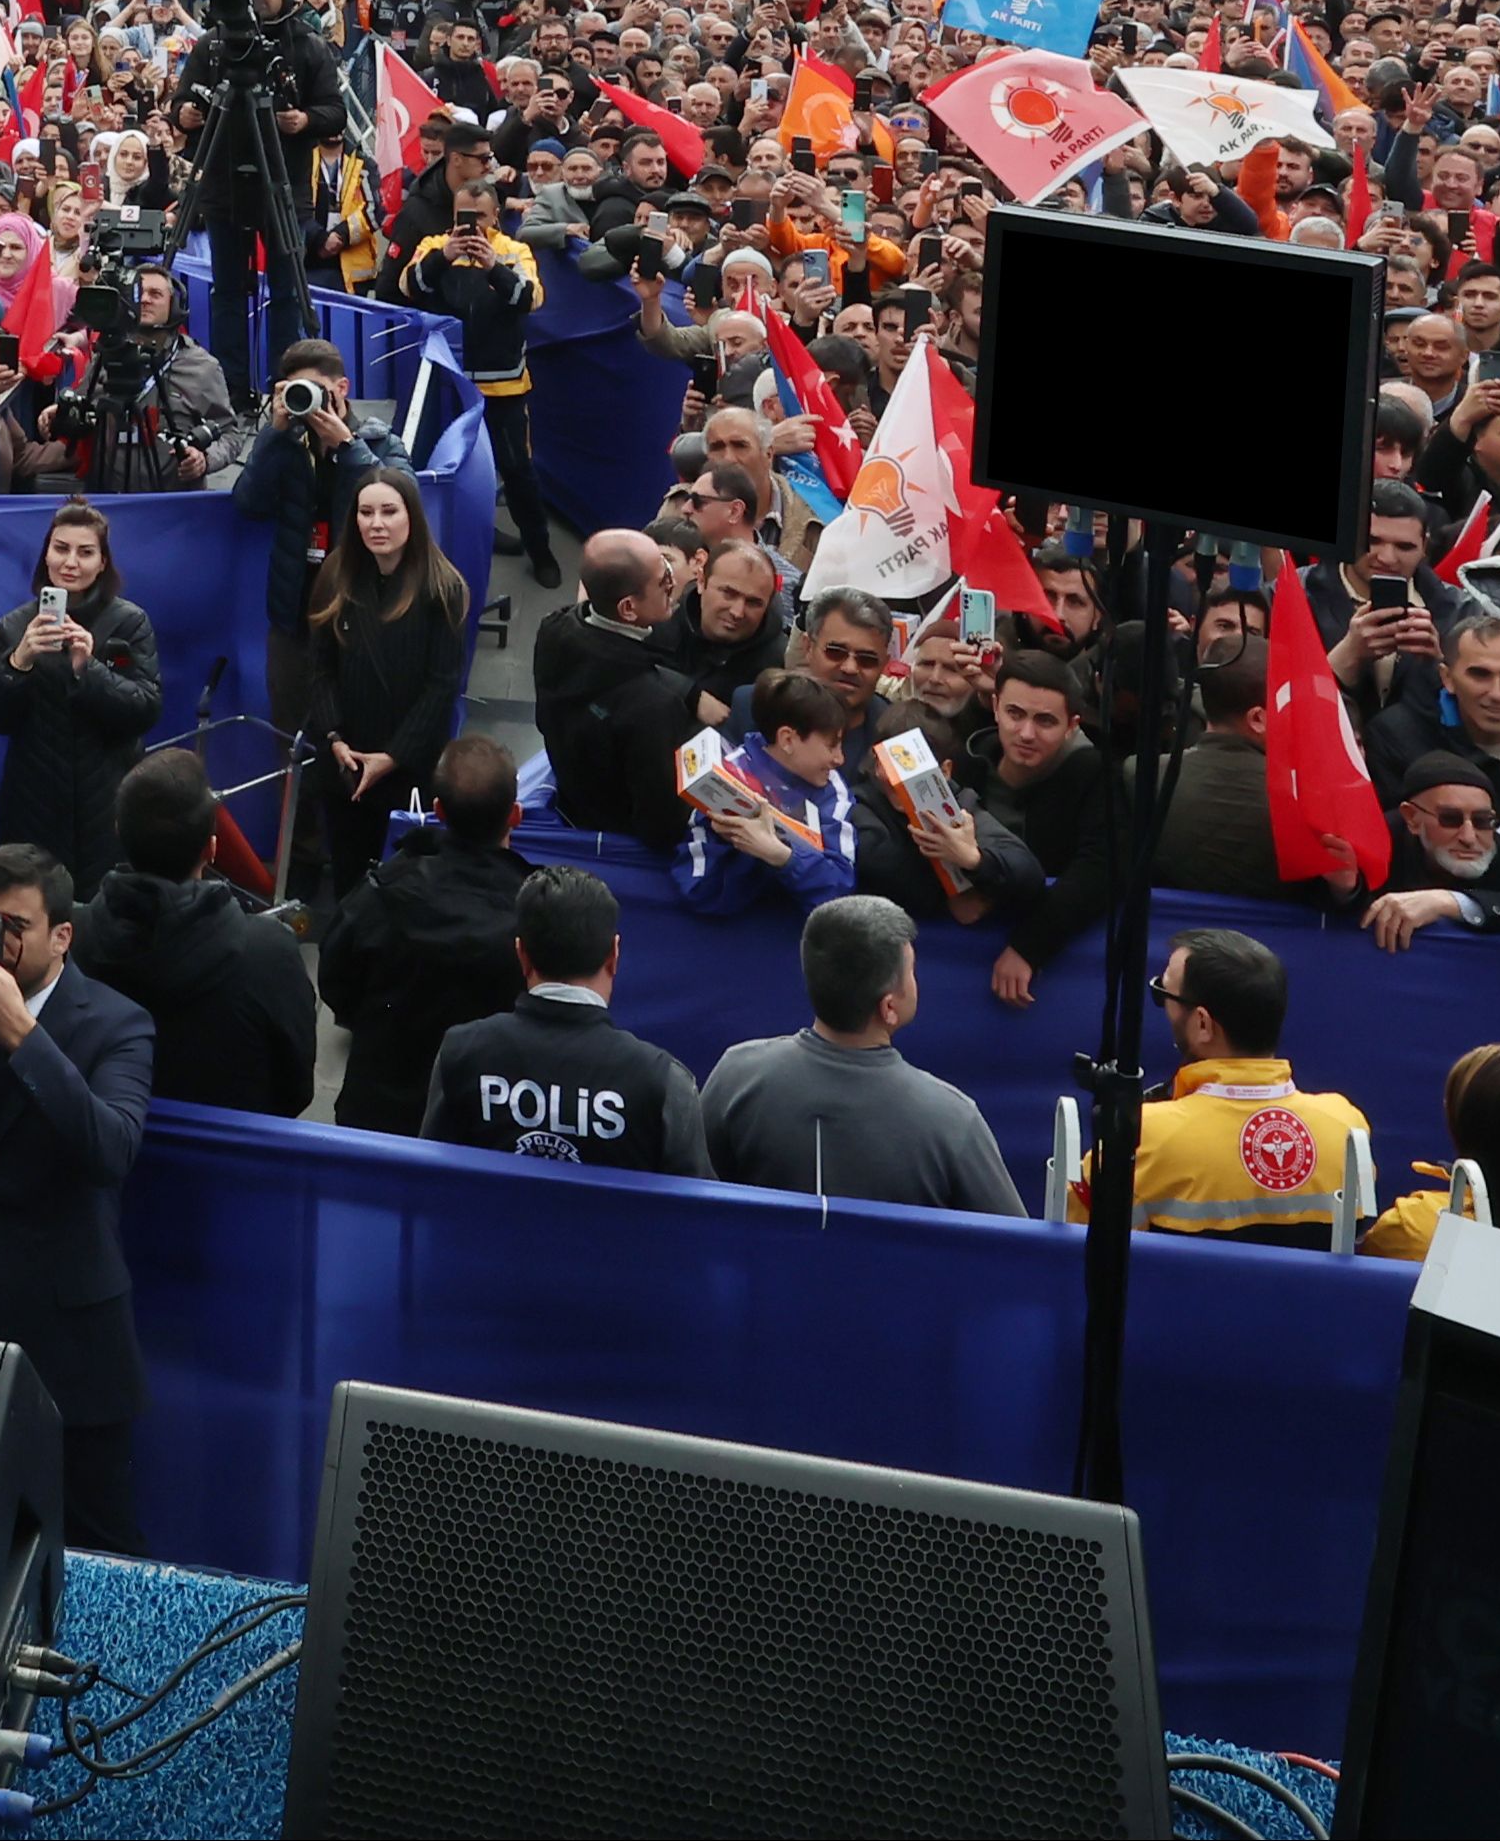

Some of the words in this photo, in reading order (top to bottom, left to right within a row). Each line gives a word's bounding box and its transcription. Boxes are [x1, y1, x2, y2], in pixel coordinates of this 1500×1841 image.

[990, 10, 1008, 23] AK
[1049, 148, 1069, 171] AK
[1069, 126, 1105, 155] PARTİ
[1218, 139, 1239, 155] AK
[125, 207, 135, 219] 2
[479, 1074, 626, 1140] POLİS
[523, 1134, 570, 1156] POLİS
